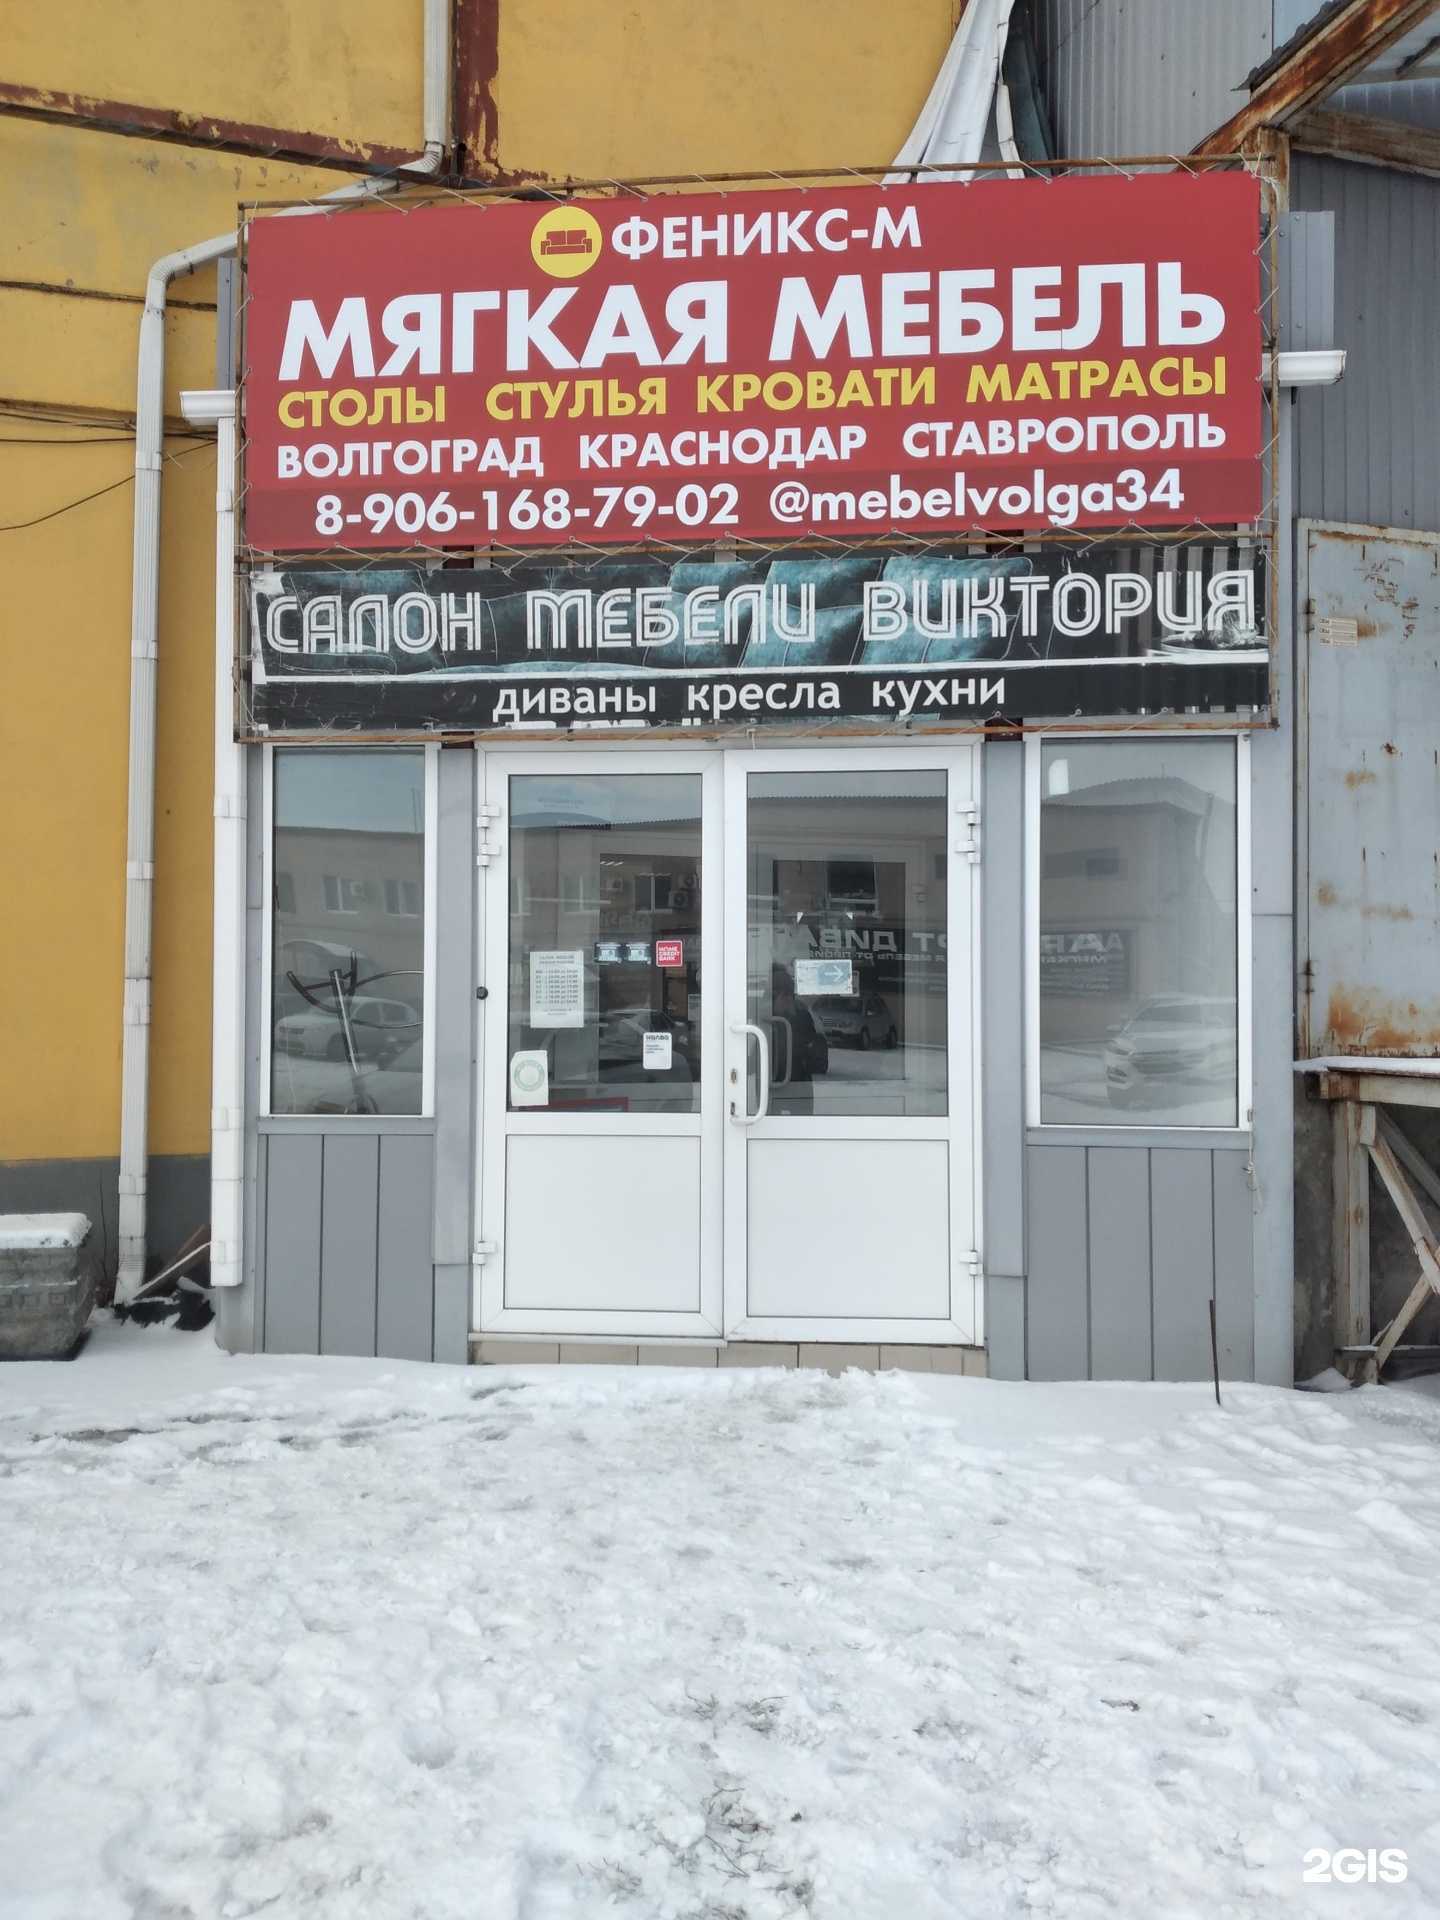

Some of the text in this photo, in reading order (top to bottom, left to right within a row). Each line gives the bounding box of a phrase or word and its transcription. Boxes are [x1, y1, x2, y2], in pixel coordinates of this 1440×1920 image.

[612, 206, 921, 260] ФЕНИКС-М
[279, 262, 1225, 381] МЯГКАЯ МЕБЕЛЬ
[279, 357, 1225, 428] СТОЛЫ СТУЛЬЯ КРОВАТИ МАТРАСЫ
[278, 414, 1225, 478] ВОЛГОГРАД КРАСНОДАР СТАВРОПОЛЬ
[316, 469, 1184, 535] 8-906-168-79-02 @mebelvolga34
[266, 570, 1254, 654] САЛОН МЕБЕЛИ ВИКТОРИЯ
[493, 678, 1004, 722] диваны кресла кухни
